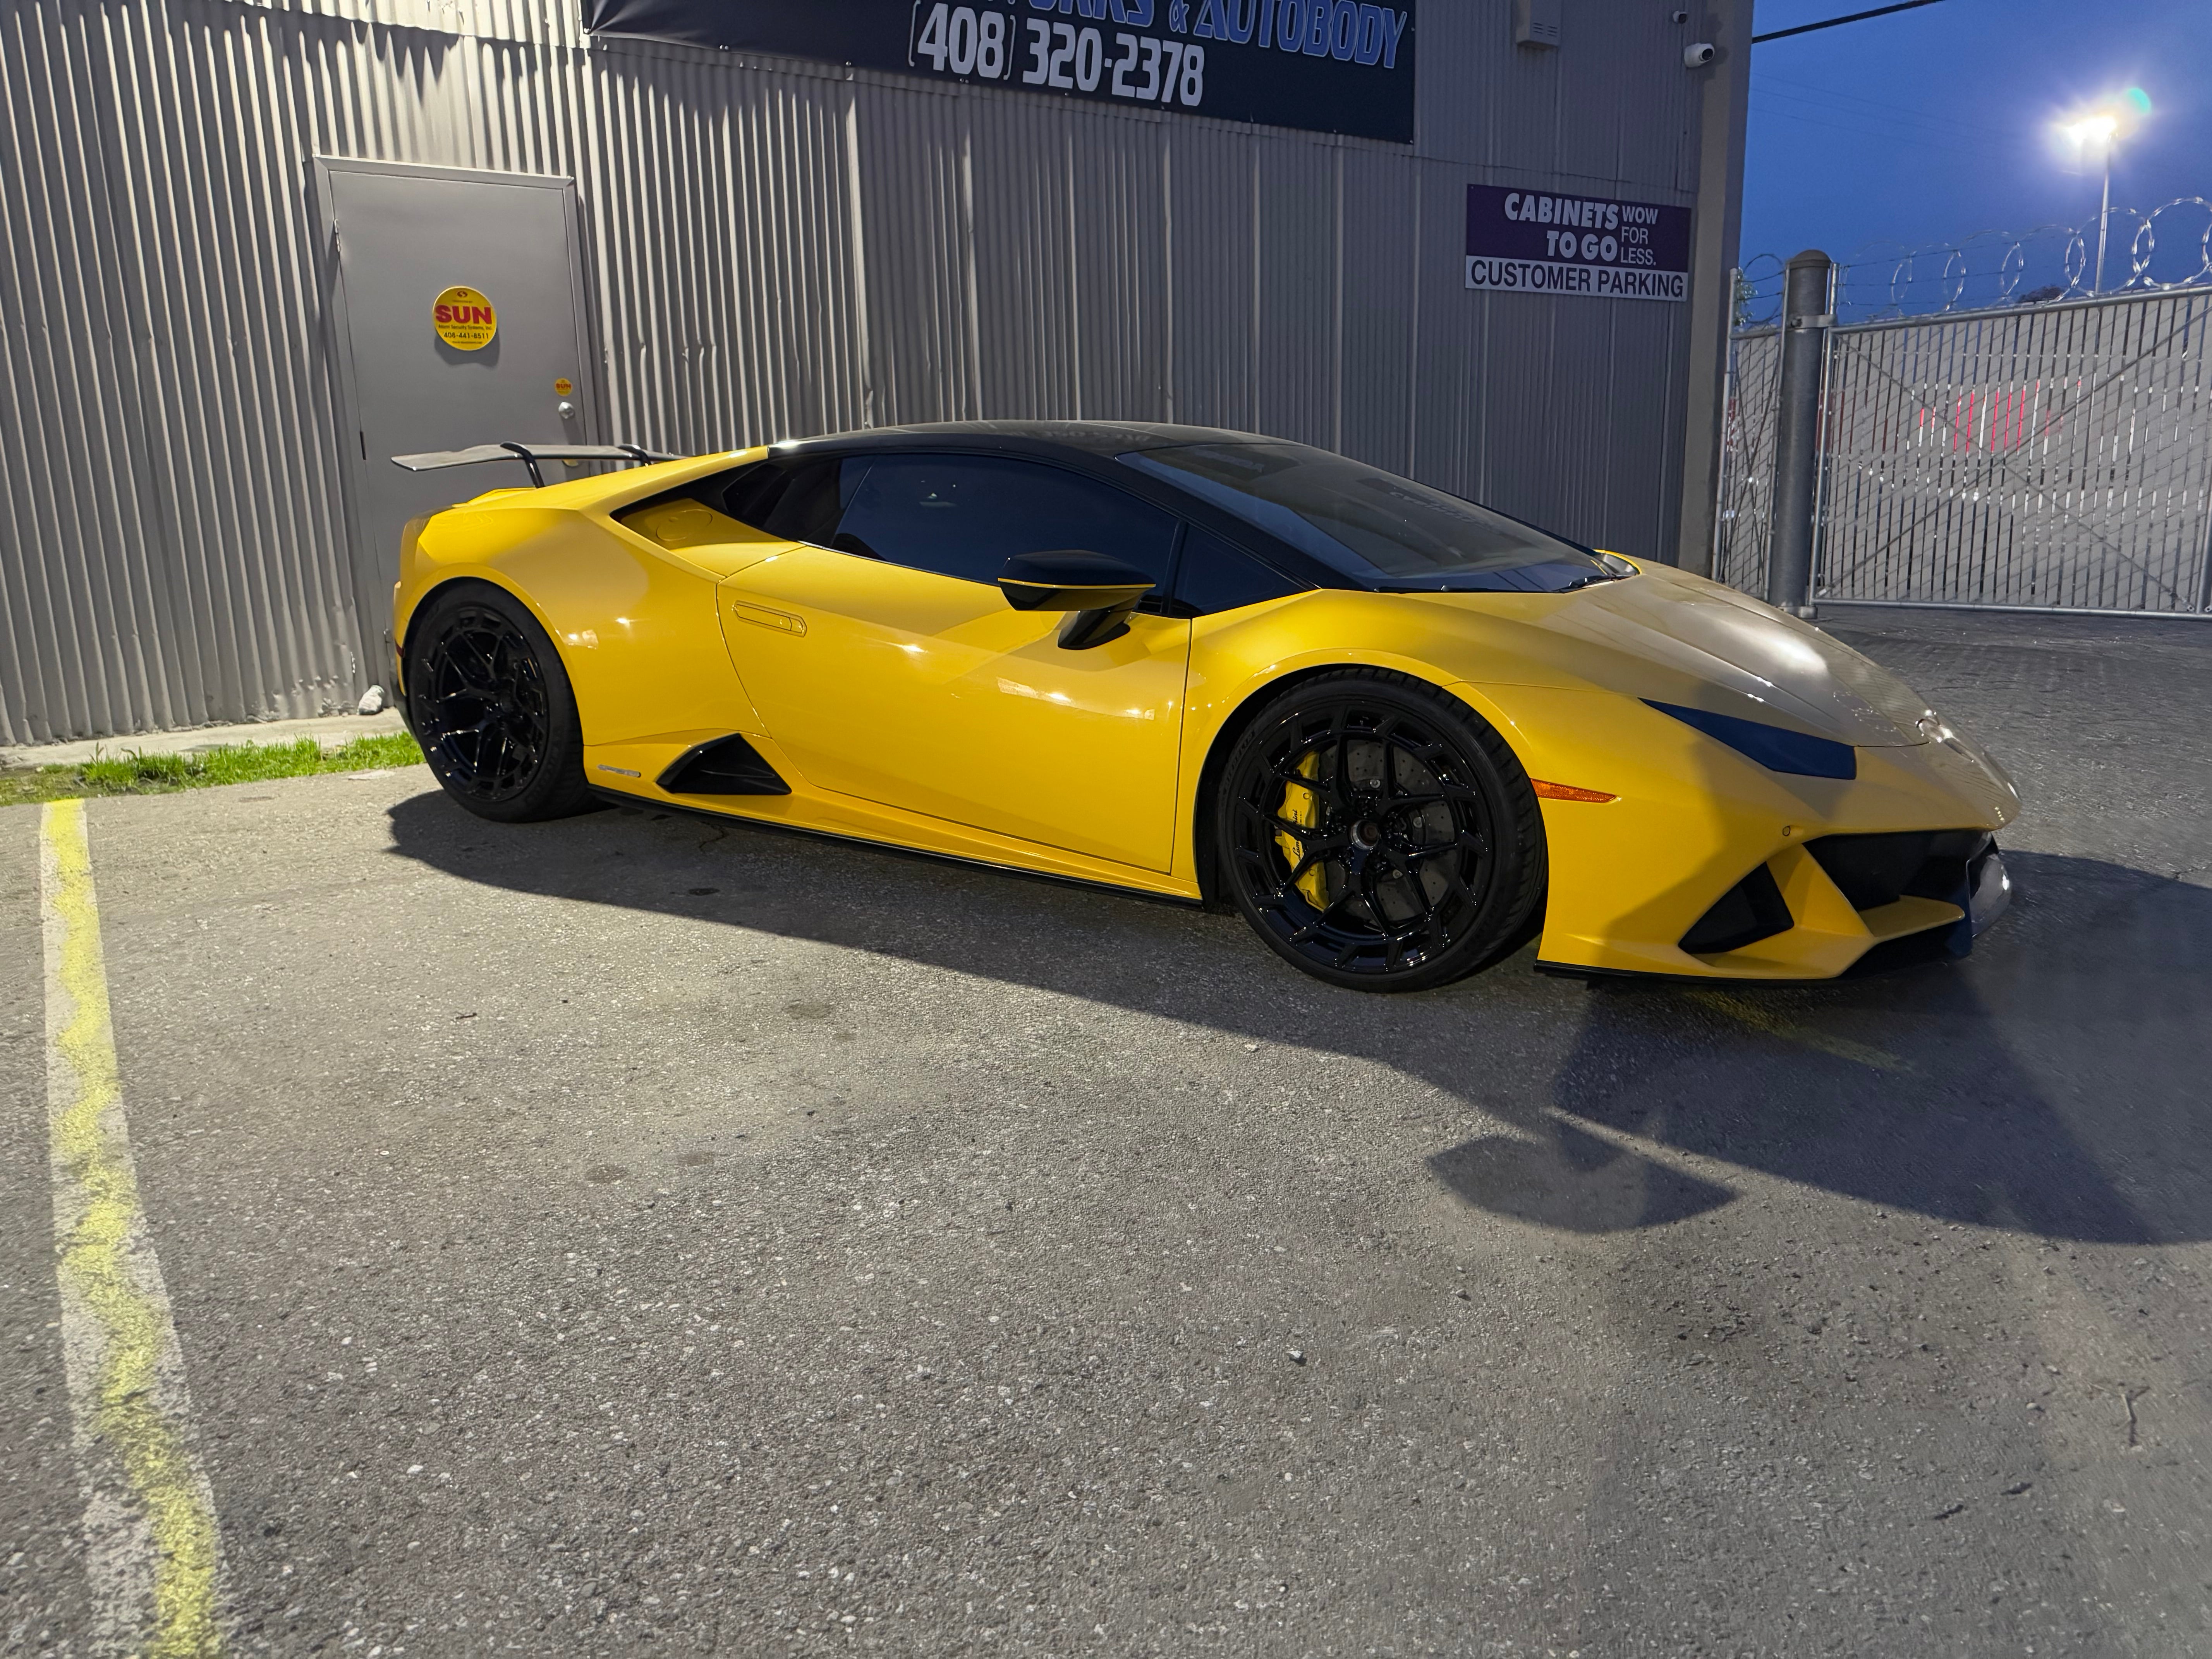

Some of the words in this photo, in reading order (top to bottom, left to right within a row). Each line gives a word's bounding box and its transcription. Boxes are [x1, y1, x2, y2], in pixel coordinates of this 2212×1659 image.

[1193, 0, 1407, 69] AUTOBODY
[908, 0, 1016, 80] (408)
[1023, 18, 1204, 106] 320-2378
[1505, 193, 1619, 230] CABINETS
[1622, 205, 1659, 225] WOW
[1547, 230, 1577, 258] TO
[1581, 234, 1618, 262] GO
[1621, 227, 1648, 244] FOR
[1620, 247, 1656, 266] LESS.
[1471, 260, 1591, 292] CUSTOMER
[1598, 270, 1683, 297] PARKING
[435, 305, 492, 324] SUN
